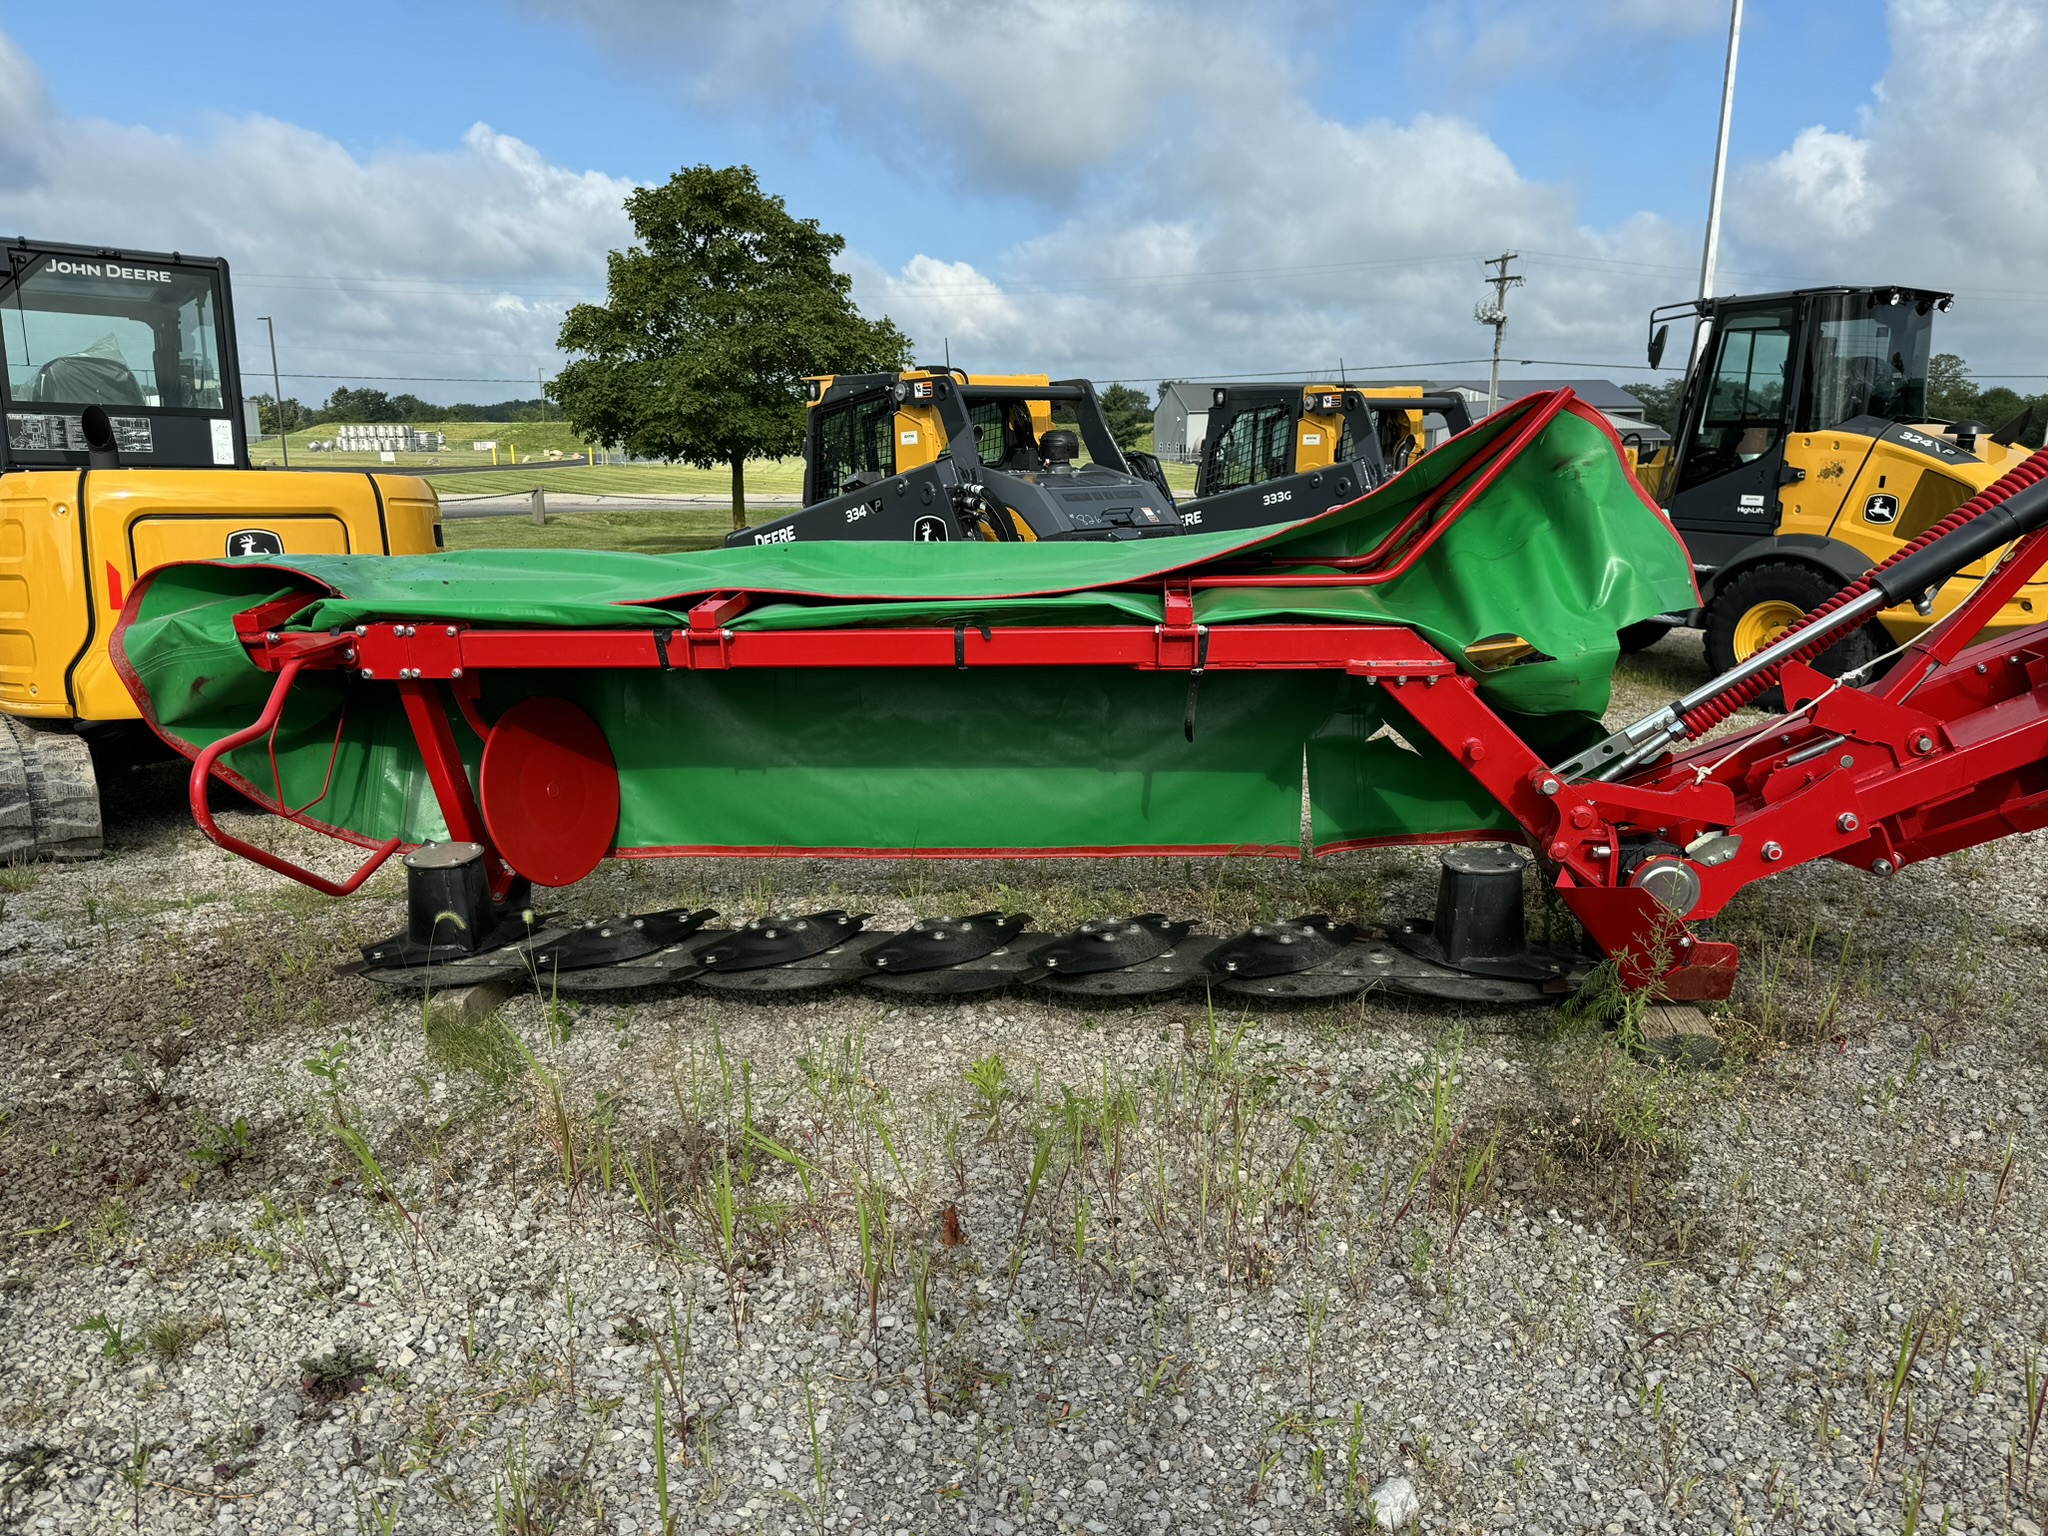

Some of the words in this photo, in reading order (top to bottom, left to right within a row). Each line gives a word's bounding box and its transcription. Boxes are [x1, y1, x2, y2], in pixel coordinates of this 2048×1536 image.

[105, 264, 172, 283] DEERE
[1899, 431, 1933, 447] 324
[1262, 490, 1292, 506] 333G
[845, 504, 867, 523] 334
[1737, 506, 1765, 515] HighLift
